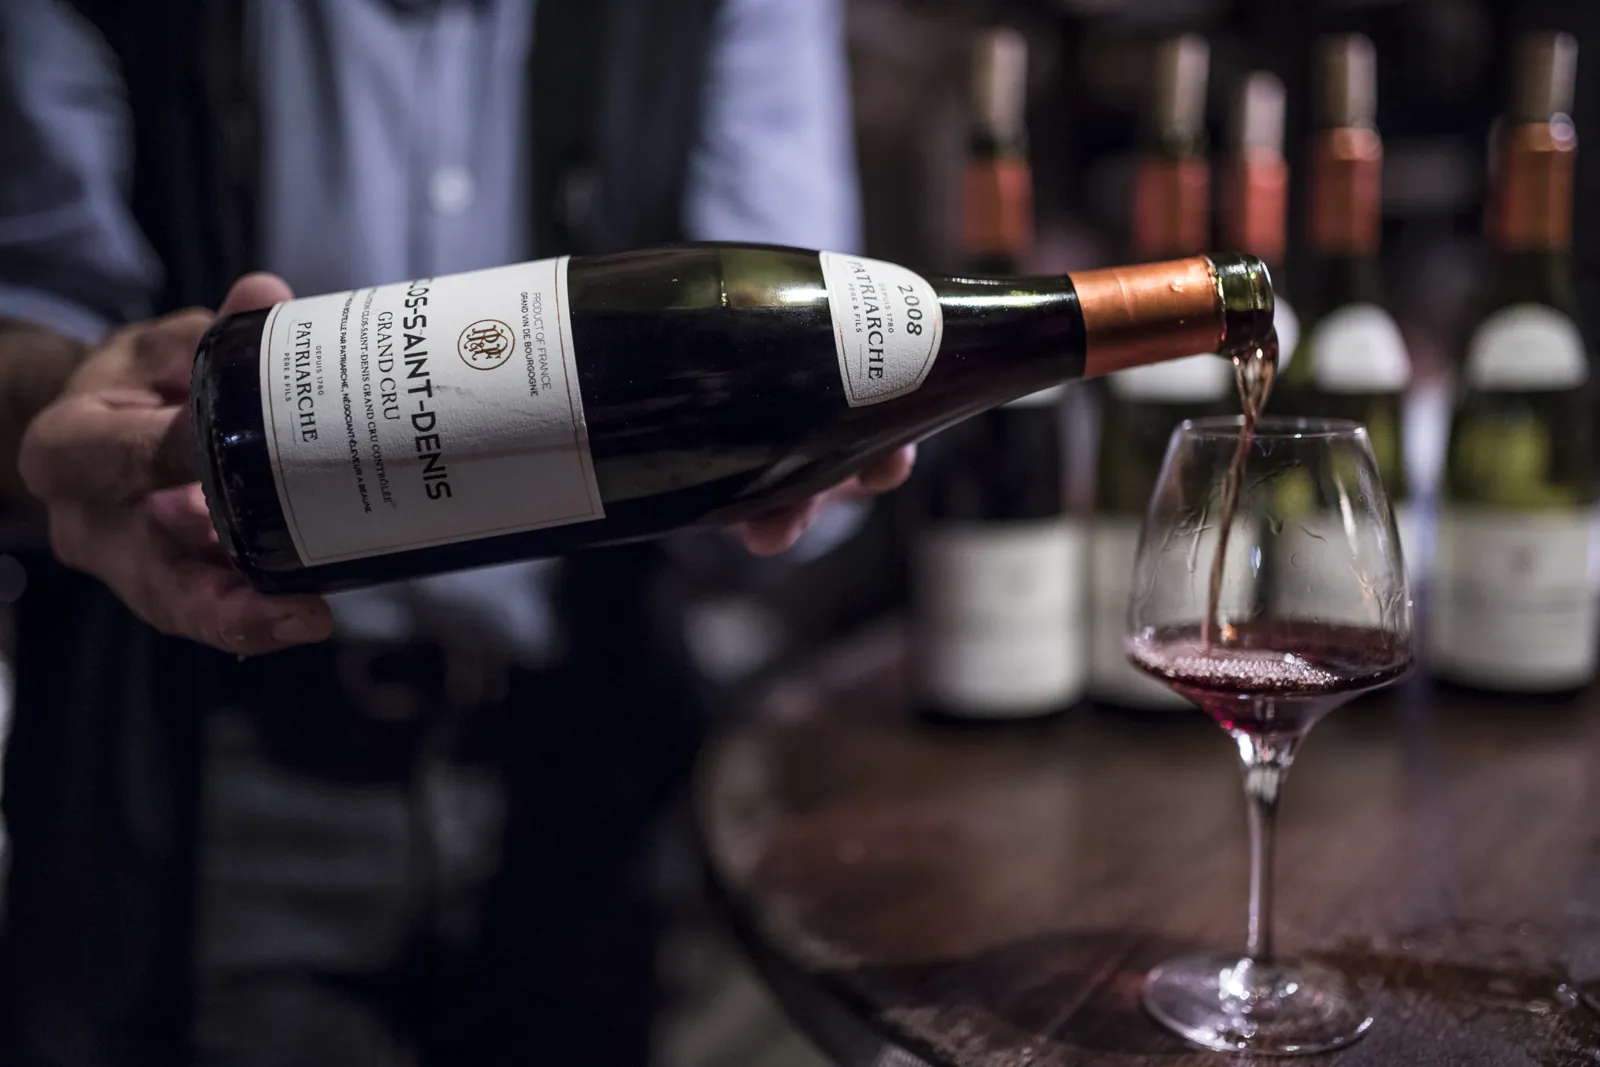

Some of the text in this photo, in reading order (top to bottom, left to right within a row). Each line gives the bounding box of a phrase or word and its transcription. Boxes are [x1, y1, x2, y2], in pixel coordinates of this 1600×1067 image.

[847, 260, 884, 380] PATRIARCHE
[854, 313, 862, 333] FILS
[879, 283, 894, 334] DEPUIS 1780
[897, 285, 923, 336] 2008
[377, 311, 401, 420] GRAND CRU
[520, 291, 539, 397] GRAND VIN DE BOURGOGNE
[532, 292, 552, 390] PRODUCT OF FRANCE
[284, 383, 292, 402] FILS
[295, 321, 318, 443] PATRIARCHE
[315, 345, 324, 396] DEPUIS 1780
[362, 384, 374, 420] GRAND
[367, 421, 378, 442] CRU
